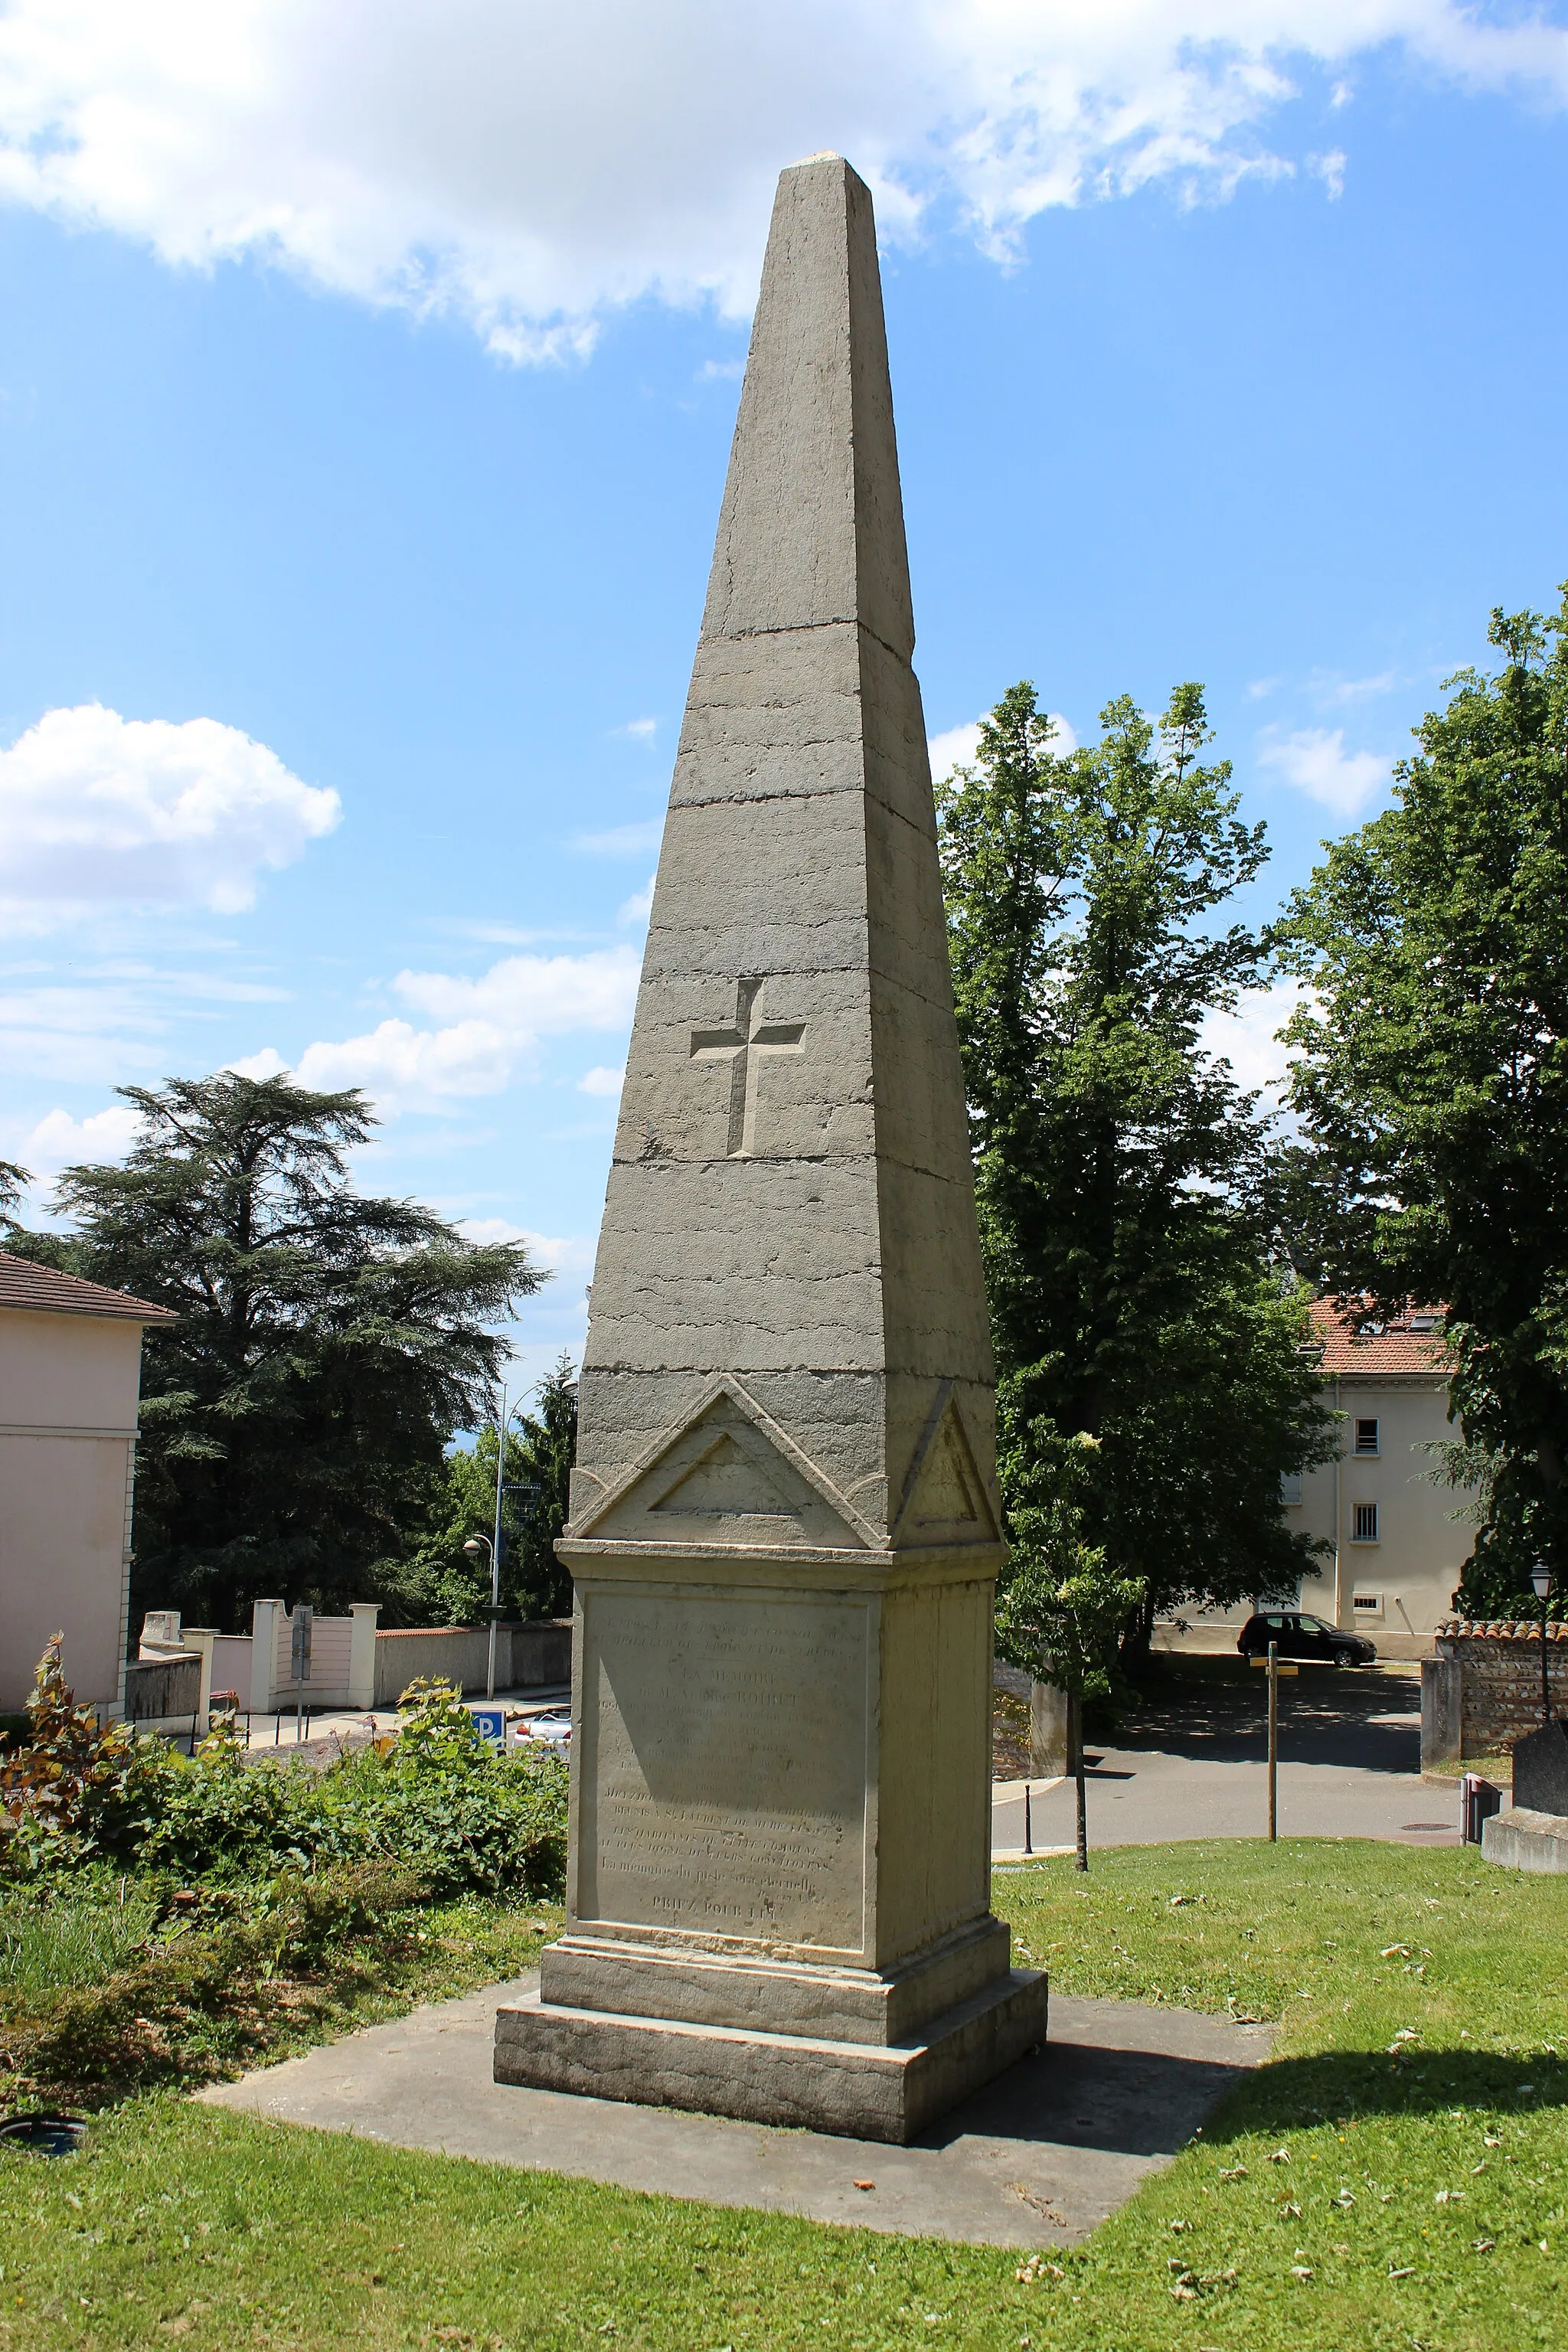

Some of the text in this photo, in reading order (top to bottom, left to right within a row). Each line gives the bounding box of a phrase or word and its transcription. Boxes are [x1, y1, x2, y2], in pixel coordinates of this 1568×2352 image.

[682, 1667, 701, 1680] LA
[479, 1717, 494, 1740] P
[734, 1815, 748, 1827] DE
[599, 1838, 610, 1848] AU
[616, 1840, 643, 1852] PLUS
[688, 1847, 704, 1858] DE
[635, 1828, 697, 1844] HABITANTS
[702, 1834, 717, 1845] DE
[722, 1837, 759, 1850] CETTE
[763, 1841, 819, 1855] COMMUNE
[602, 1855, 616, 1871] La
[619, 1858, 671, 1877] mémoire
[675, 1863, 691, 1879] du
[694, 1867, 724, 1886] juste
[730, 1874, 755, 1886] sera
[652, 1895, 695, 1913] PRIEZ
[705, 1901, 741, 1918] POUR
